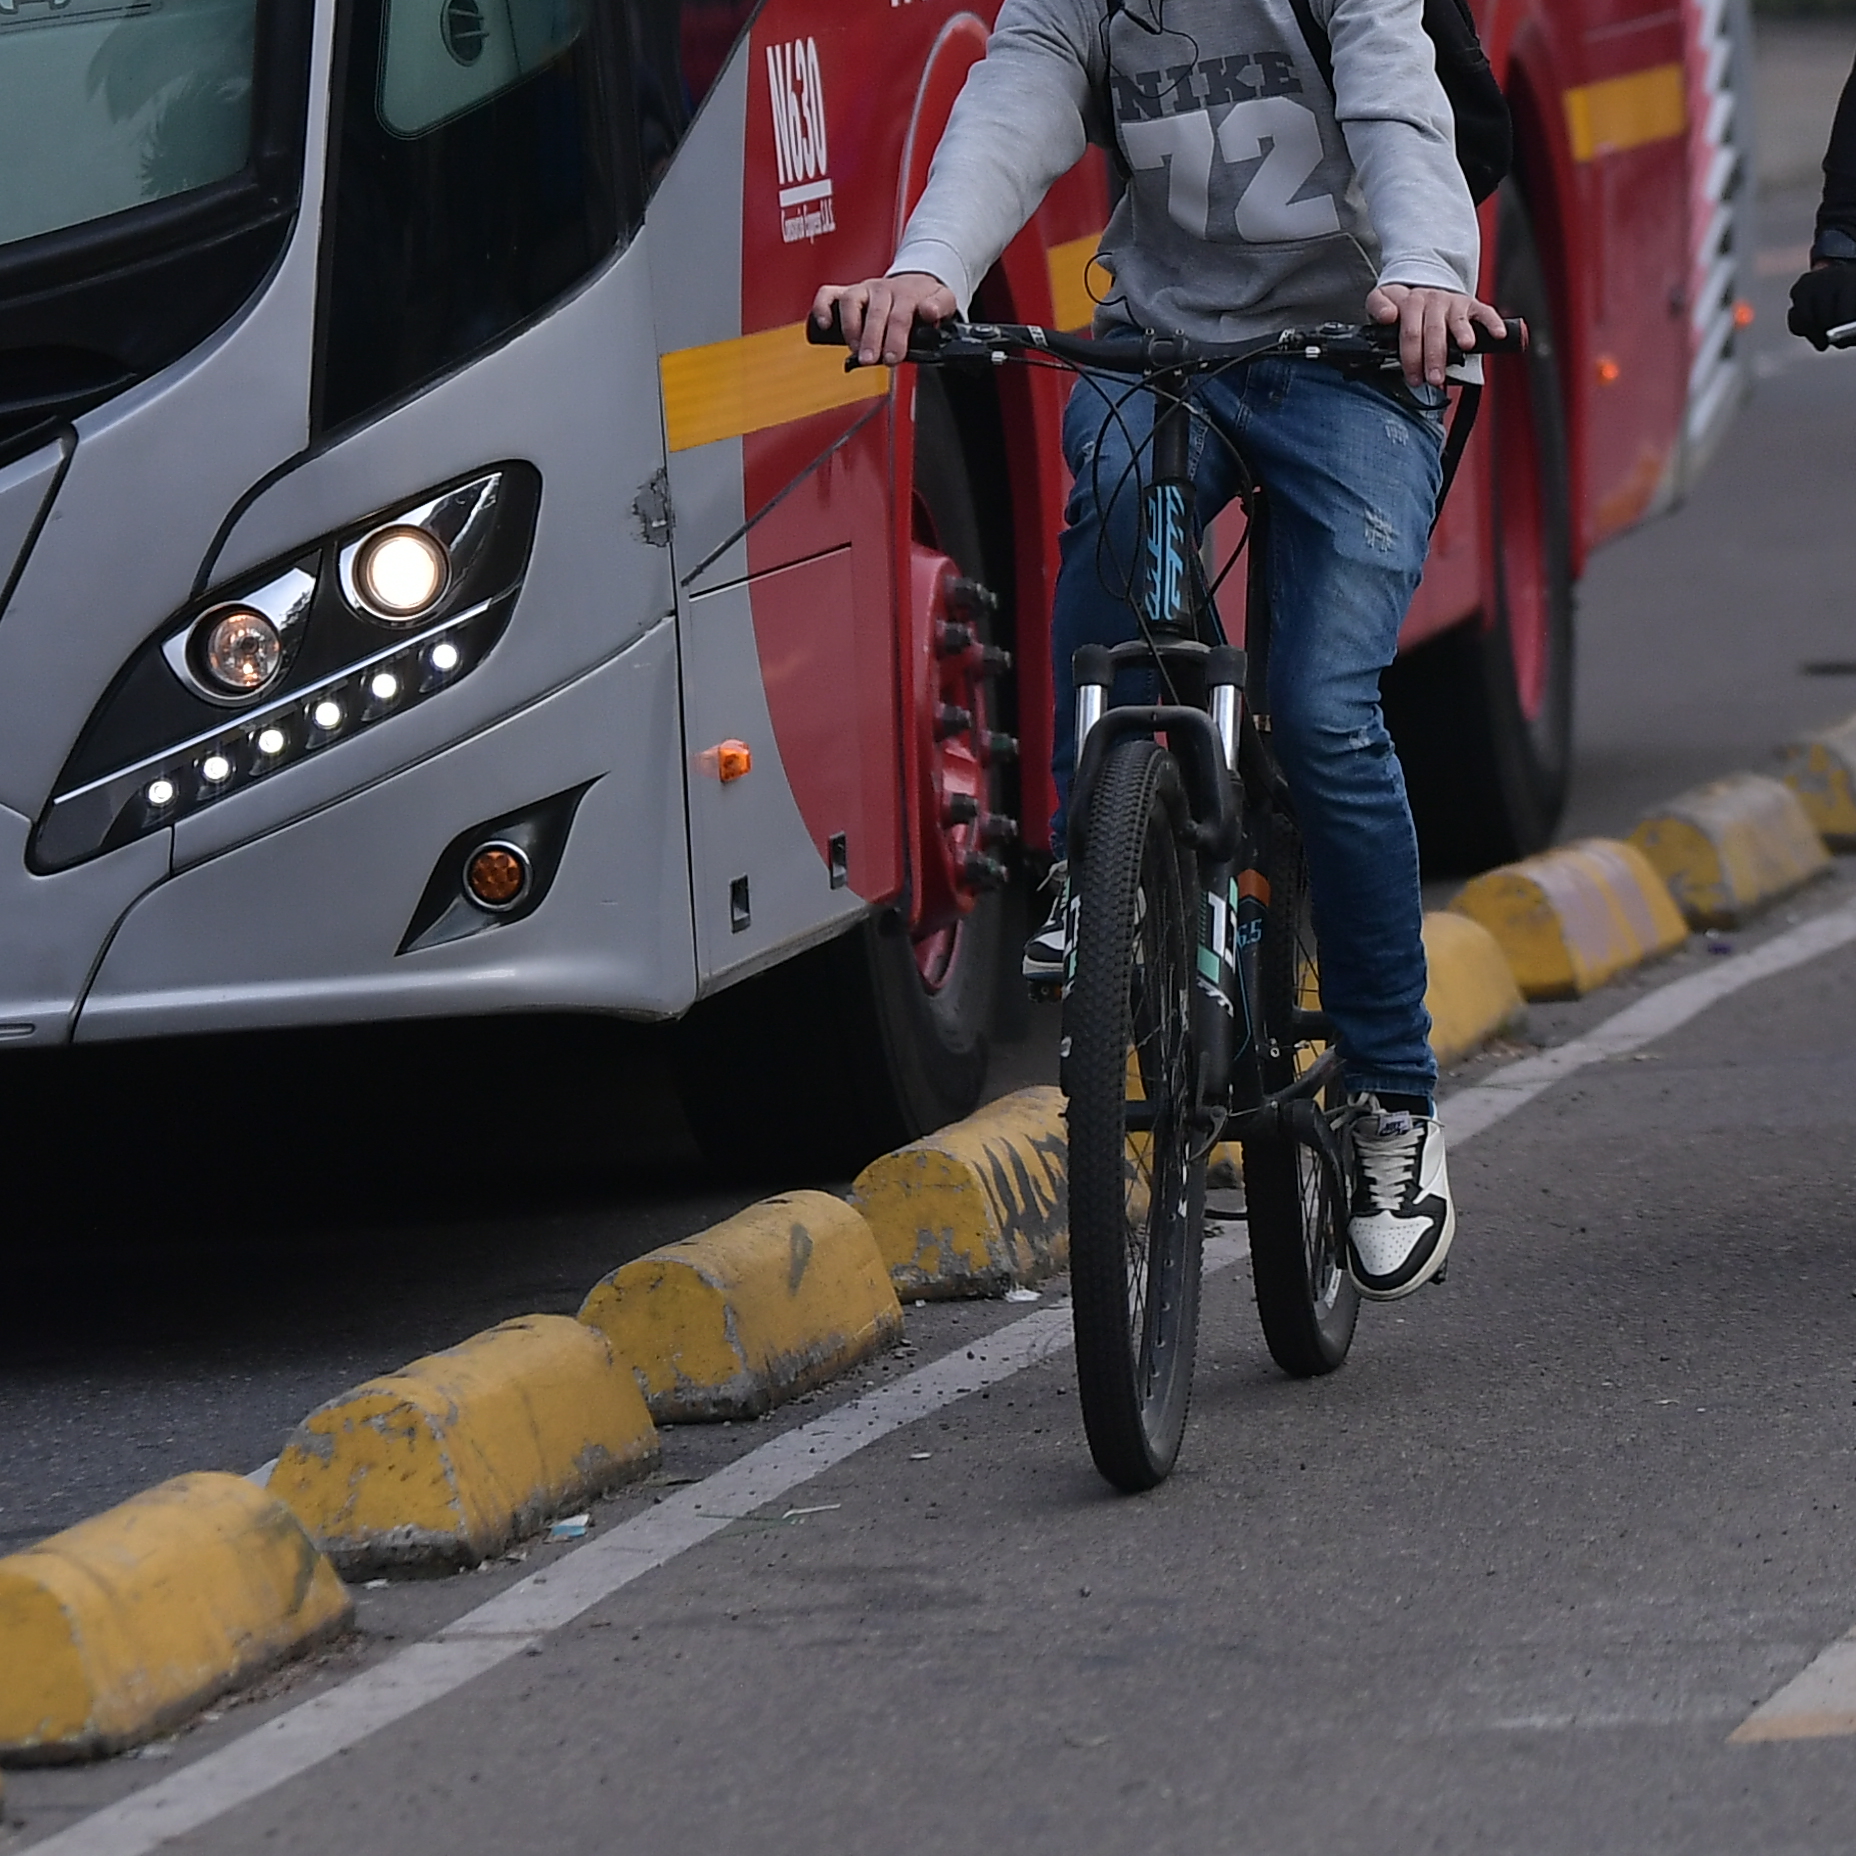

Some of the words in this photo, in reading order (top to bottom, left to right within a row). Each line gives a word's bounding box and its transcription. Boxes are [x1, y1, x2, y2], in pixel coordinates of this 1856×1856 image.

[766, 36, 827, 185] N630
[1111, 51, 1304, 121] NIKE
[1121, 96, 1341, 243] 72
